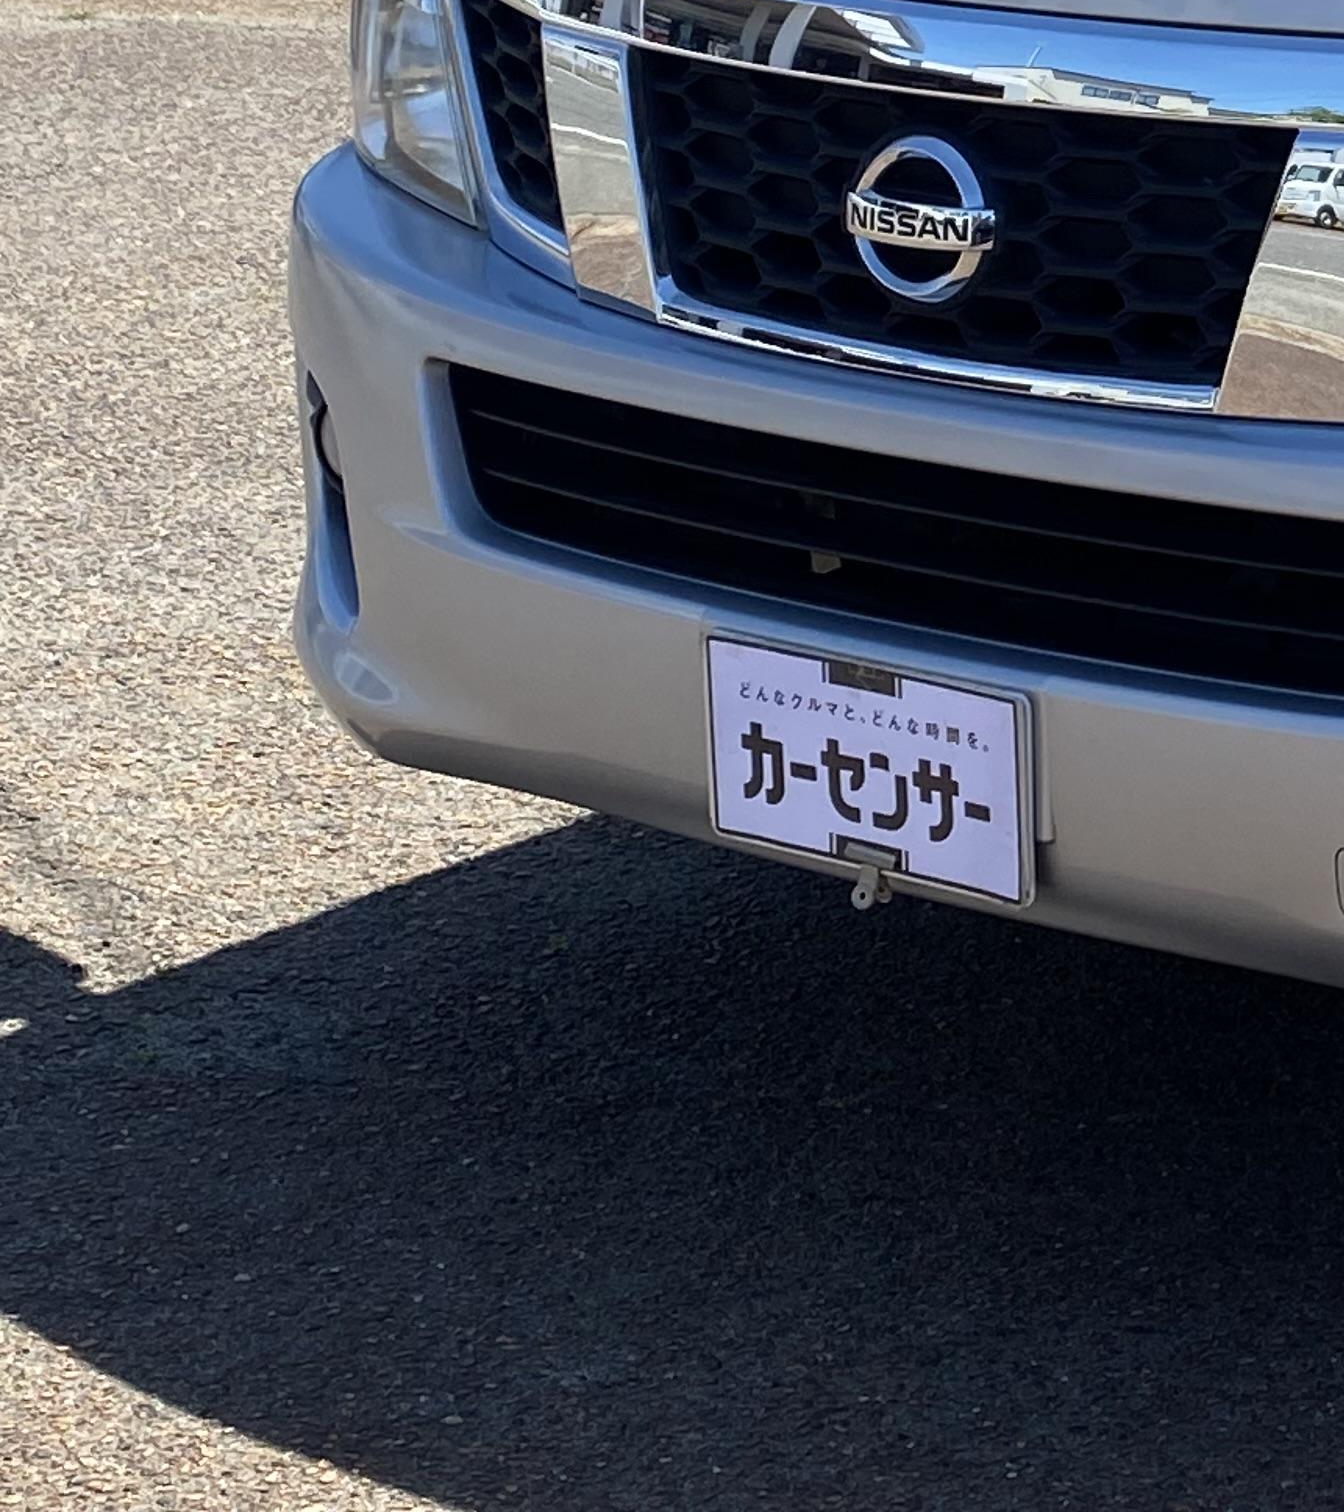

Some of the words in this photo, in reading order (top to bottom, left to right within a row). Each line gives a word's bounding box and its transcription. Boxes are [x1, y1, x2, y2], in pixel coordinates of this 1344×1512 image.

[850, 199, 970, 243] NISSAN
[739, 681, 991, 753] どんなクルマと、どんな時間を。
[740, 720, 992, 843] カーセンサー
